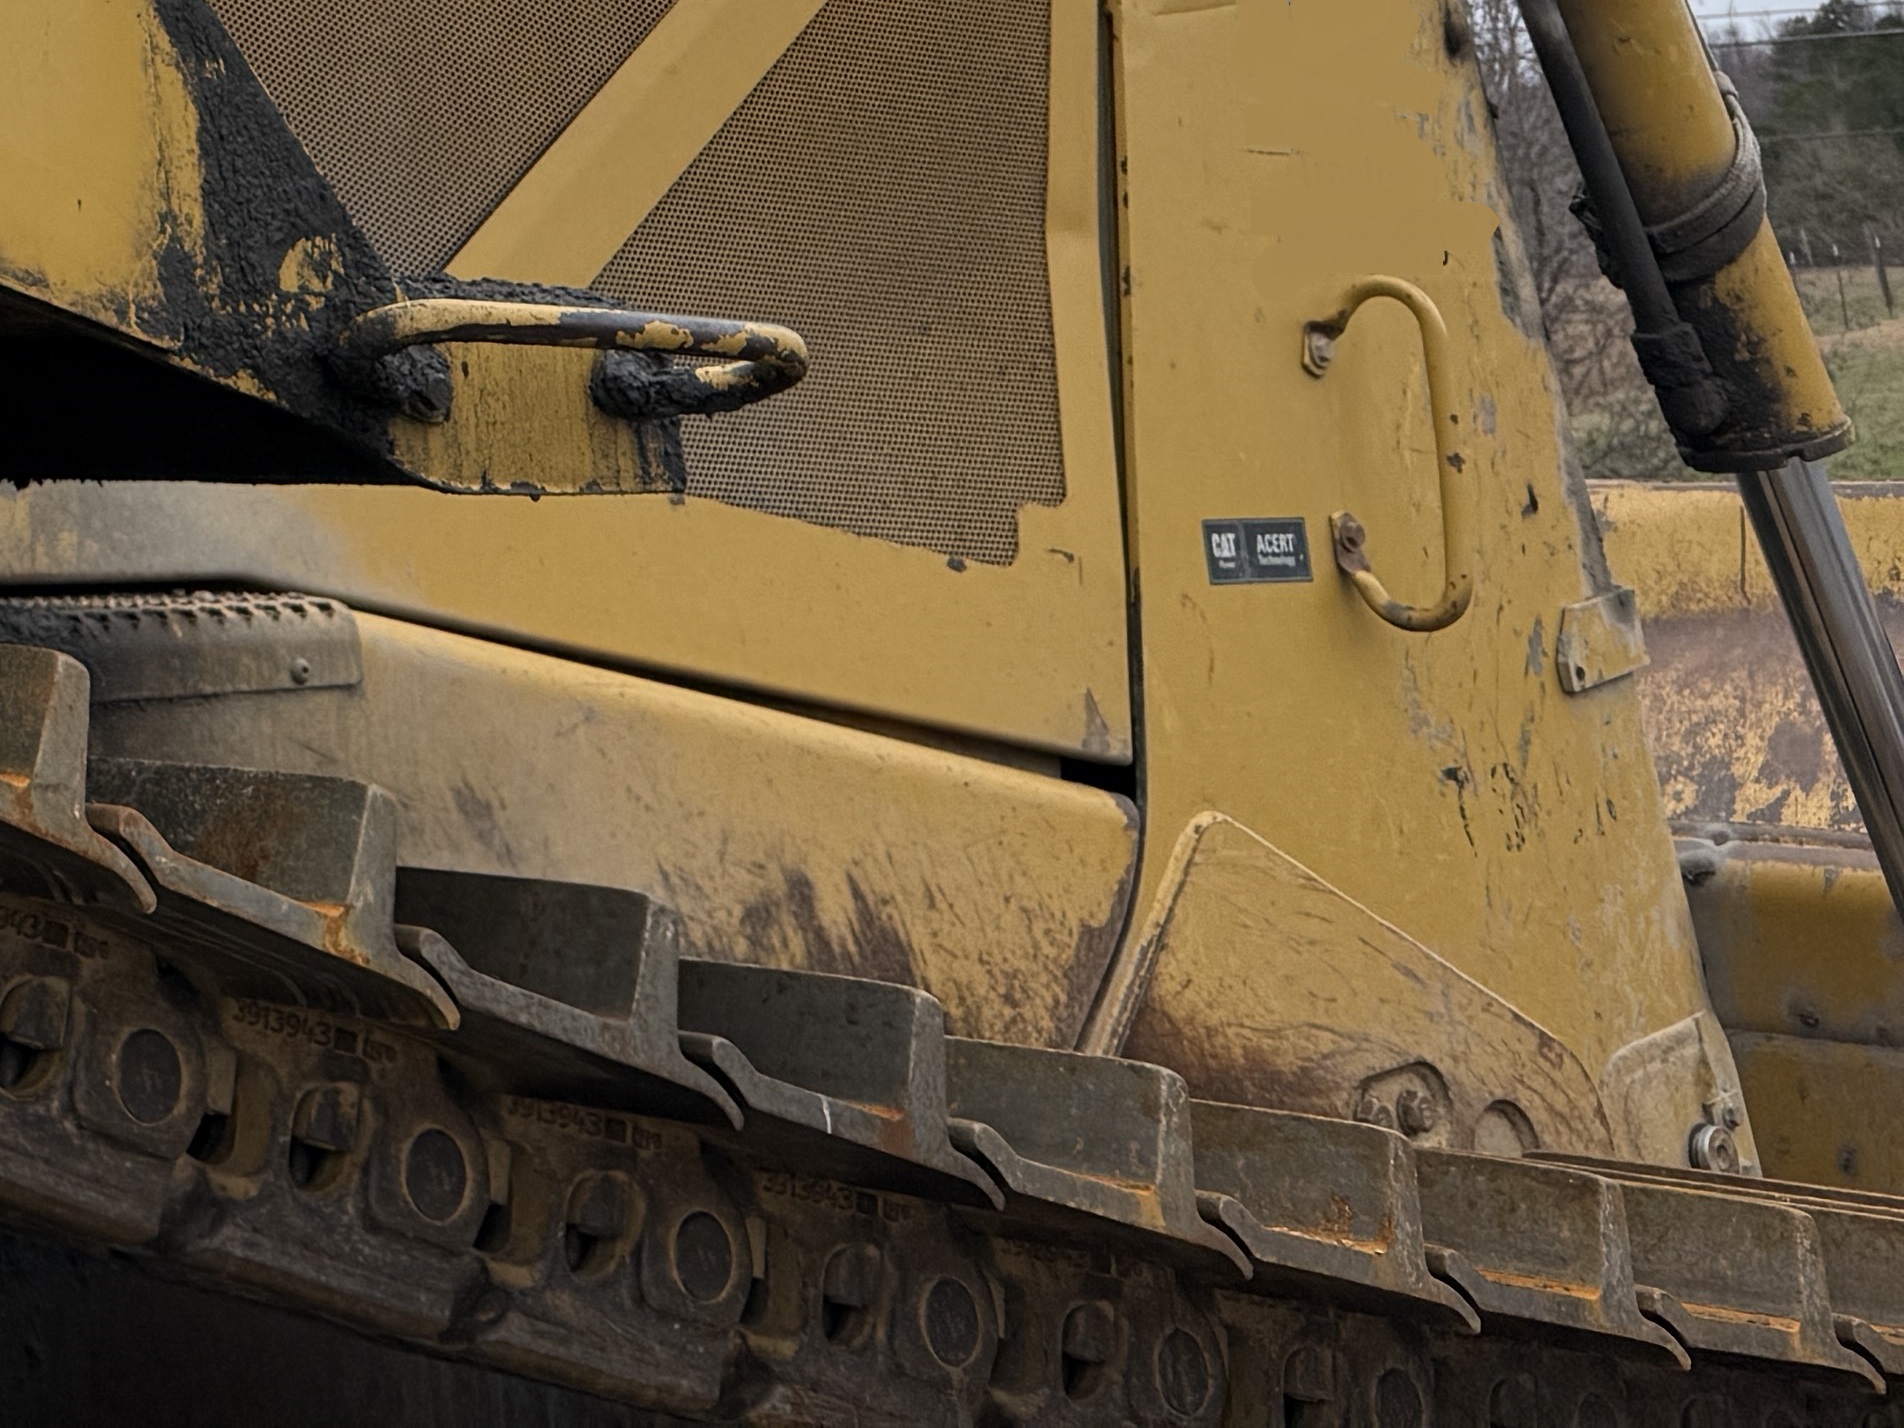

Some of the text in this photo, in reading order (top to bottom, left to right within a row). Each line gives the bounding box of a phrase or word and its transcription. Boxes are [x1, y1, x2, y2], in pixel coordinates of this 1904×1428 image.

[1211, 532, 1236, 558] CAT
[1256, 533, 1294, 553] ACERT
[232, 1001, 332, 1047] 3913943
